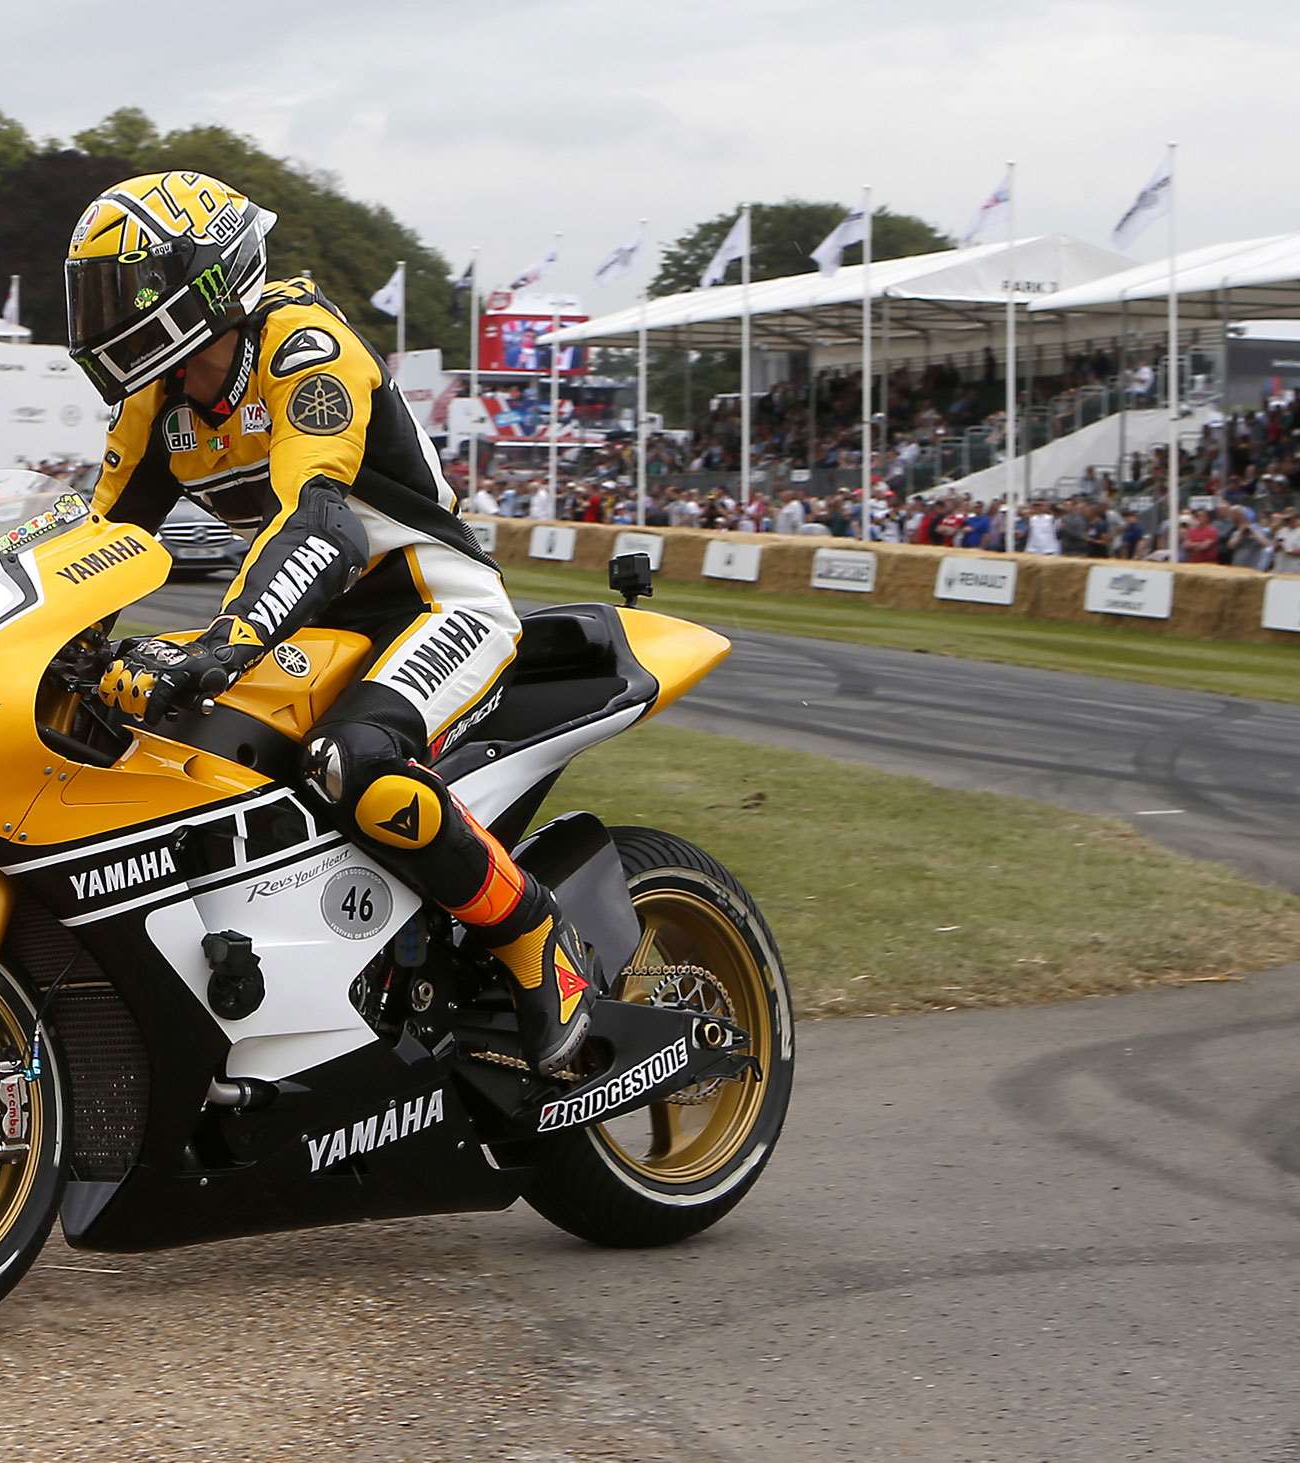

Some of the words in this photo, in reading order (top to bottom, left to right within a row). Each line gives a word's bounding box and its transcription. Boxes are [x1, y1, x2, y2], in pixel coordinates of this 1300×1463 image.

[212, 207, 244, 241] agv
[228, 338, 254, 406] DAINESE
[57, 536, 147, 585] YAMAHA
[248, 535, 340, 636] YAMAHA
[392, 610, 490, 700] YAMAHA
[70, 847, 177, 900] YAMAHA
[246, 874, 293, 903] Revs
[295, 864, 323, 889] Your
[321, 849, 350, 871] Heart
[341, 885, 373, 922] 46
[6, 1083, 20, 1135] brembo
[537, 1036, 689, 1132] BRIDGESTONE
[307, 1089, 444, 1173] YAMAHA
